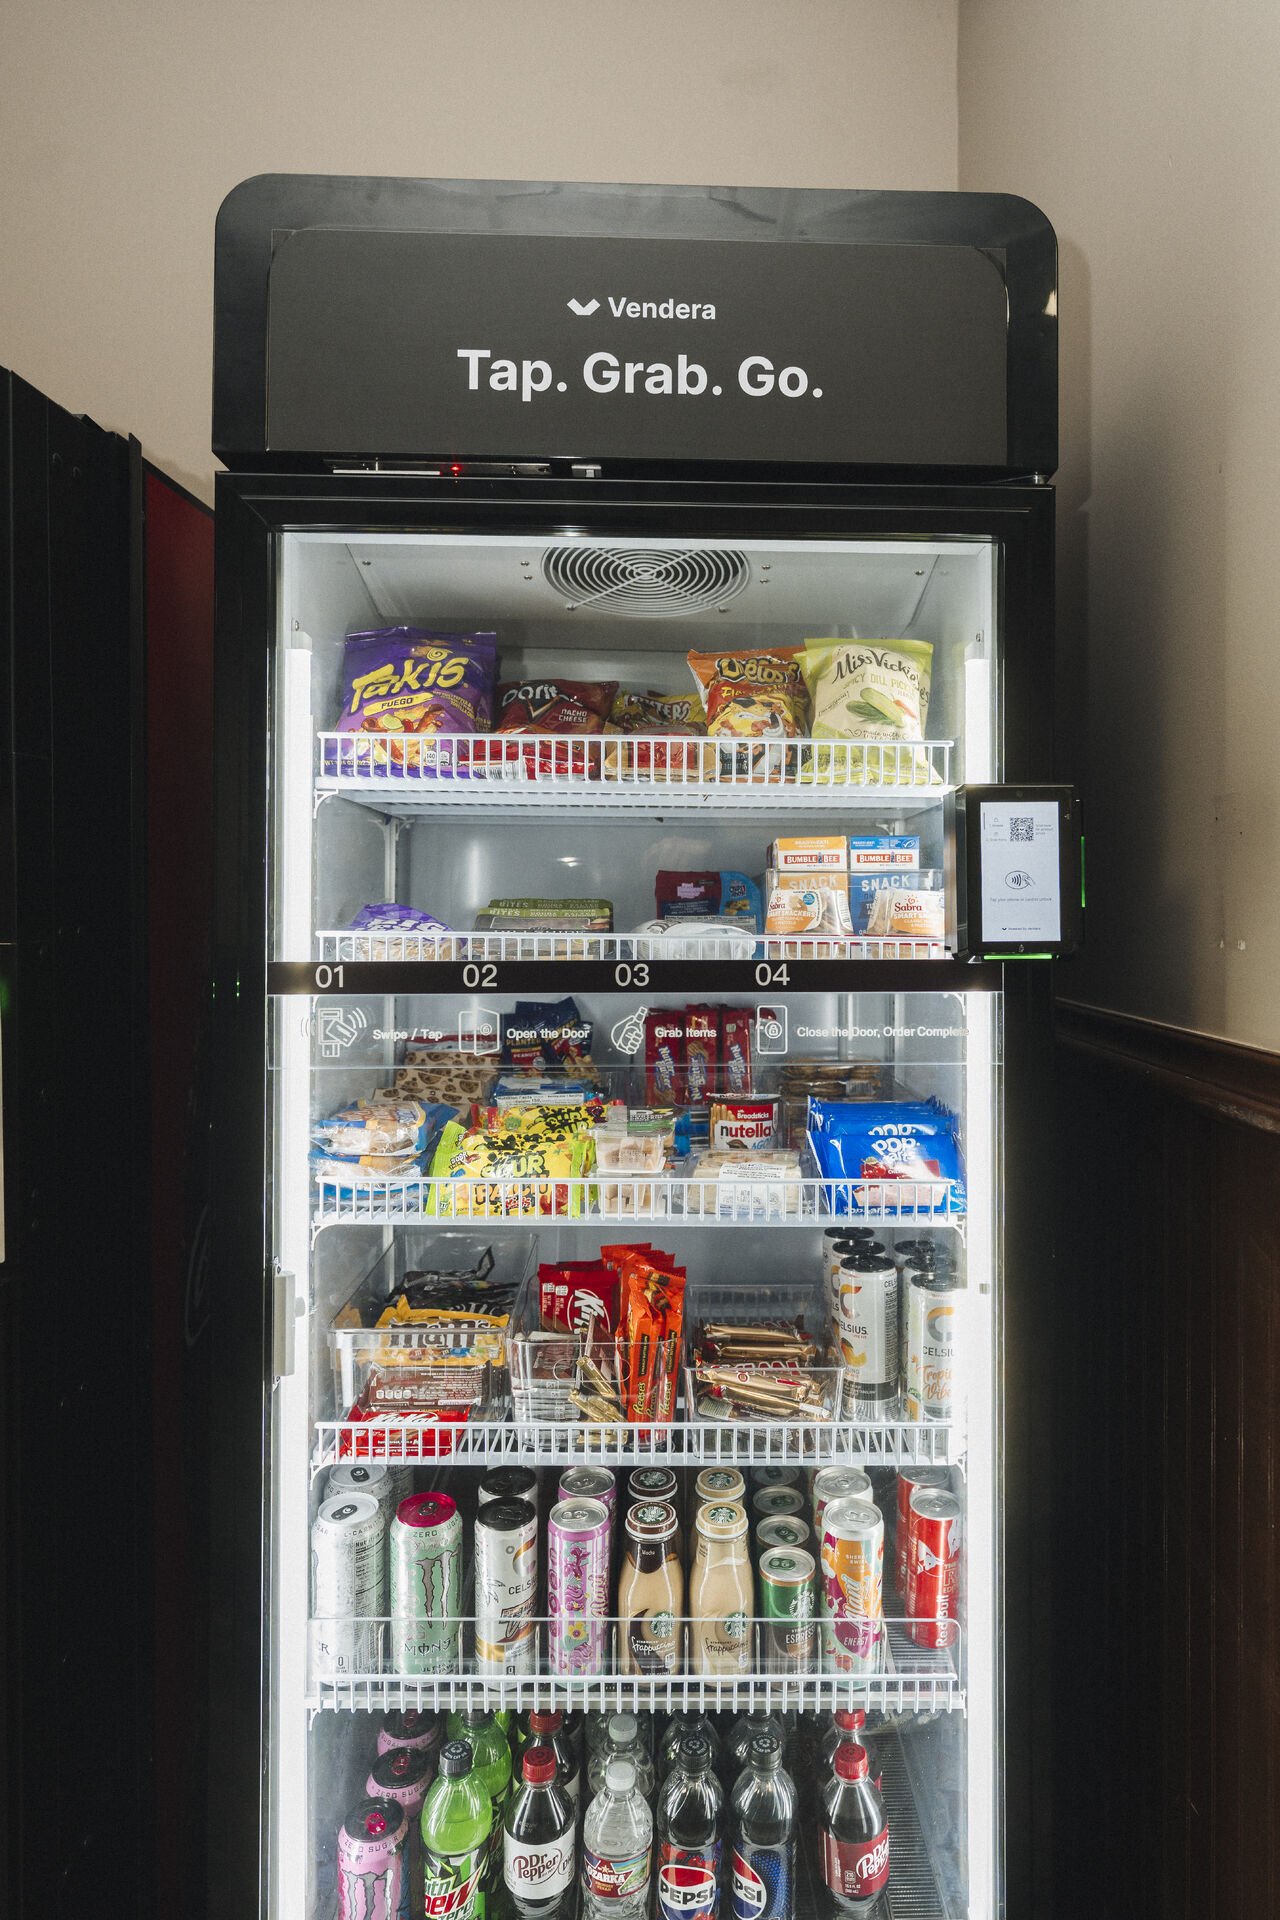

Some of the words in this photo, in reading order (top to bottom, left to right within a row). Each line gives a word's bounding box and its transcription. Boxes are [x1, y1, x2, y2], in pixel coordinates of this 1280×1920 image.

[607, 297, 717, 320] Vendera
[457, 349, 568, 402] Tap.
[582, 351, 723, 396] Grab.
[738, 355, 824, 398] Go.
[832, 653, 873, 684] Miss
[381, 697, 413, 709] FUEGO
[559, 715, 587, 723] CHEESE
[787, 855, 817, 864] BUMBLE
[823, 855, 838, 863] BEE
[789, 875, 838, 891] SNACK
[861, 875, 910, 892] SNACK
[894, 902, 922, 912] Sabra
[315, 964, 345, 989] 01
[462, 963, 498, 988] 02
[614, 963, 650, 987] 03
[755, 963, 791, 987] 04
[372, 1029, 408, 1041] Swipe
[421, 1029, 443, 1041] Tap
[506, 1028, 537, 1041] Open
[540, 1028, 559, 1038] the
[561, 1028, 590, 1039] Door
[655, 1028, 683, 1038] Grab
[686, 1028, 717, 1038] Items
[796, 1026, 829, 1038] Close
[831, 1027, 849, 1037] the
[851, 1026, 881, 1039] Door,
[883, 1026, 916, 1038] Order
[917, 1026, 970, 1039] Complete
[737, 1112, 770, 1120] Breadsticks
[720, 1123, 772, 1138] nutella
[481, 1153, 545, 1178] SOUR
[839, 1319, 868, 1336] ELSIUS
[413, 1530, 438, 1538] ZERO
[935, 1594, 949, 1619] Bull
[935, 1619, 949, 1648] Red
[513, 1853, 561, 1882] Pepper
[528, 1853, 548, 1866] Dr
[587, 1866, 627, 1884] OZARKA
[660, 1878, 714, 1906] PEPSI
